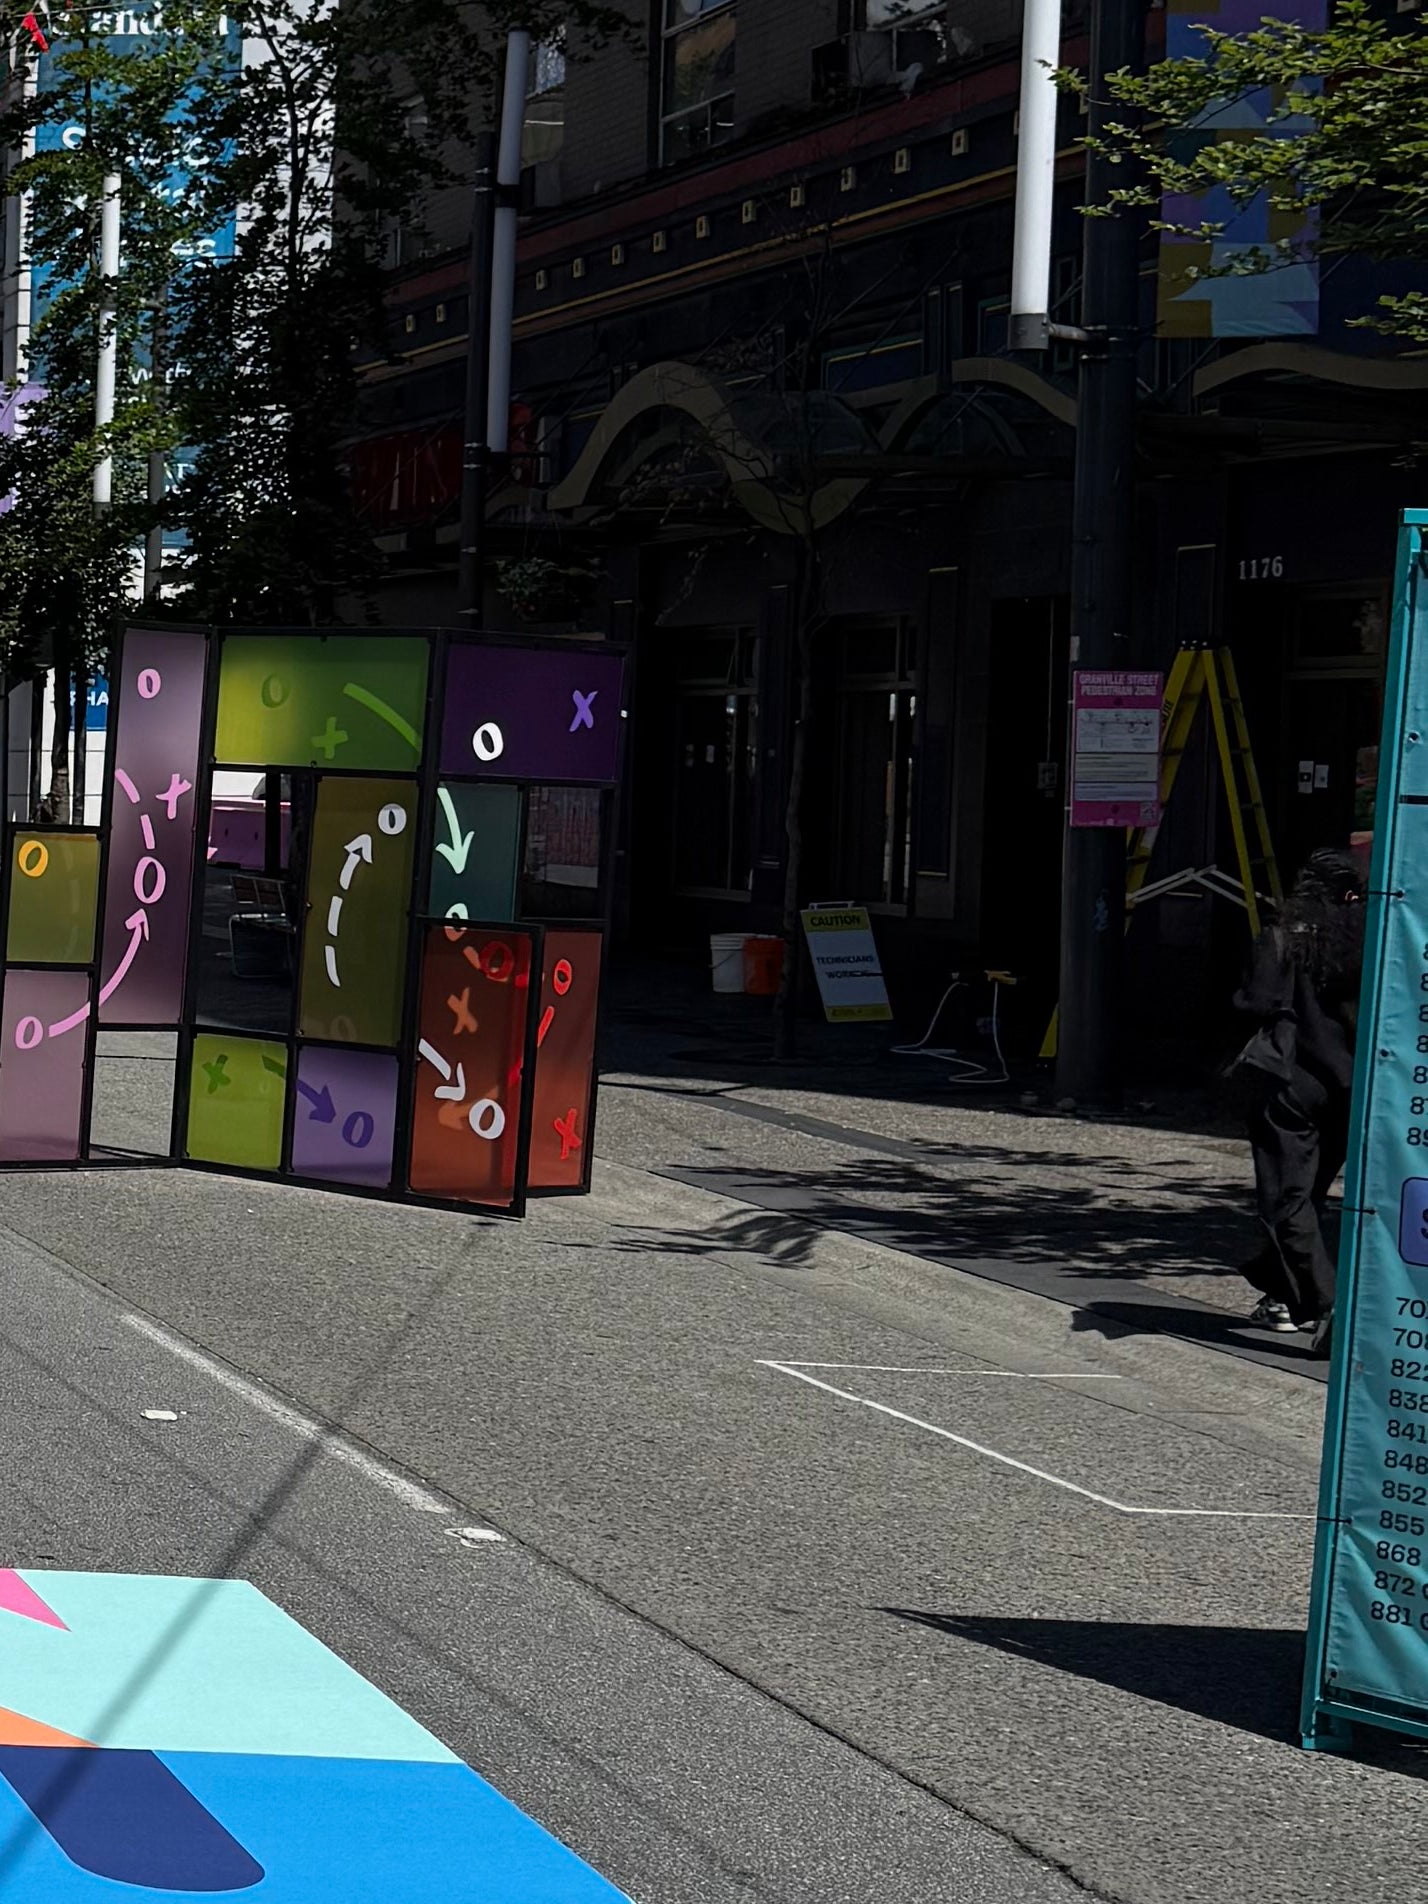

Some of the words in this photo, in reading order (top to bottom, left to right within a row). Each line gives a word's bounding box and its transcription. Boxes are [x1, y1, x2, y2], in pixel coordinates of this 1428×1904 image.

[1239, 555, 1284, 581] 1176
[810, 915, 860, 927] CAUTION
[1386, 1418, 1427, 1444] 841
[1383, 1449, 1428, 1475] 848
[1381, 1479, 1427, 1507] 852
[1378, 1509, 1425, 1537] 855
[1375, 1540, 1422, 1567] 868
[1373, 1570, 1416, 1597] 872
[1370, 1600, 1413, 1627] 881
